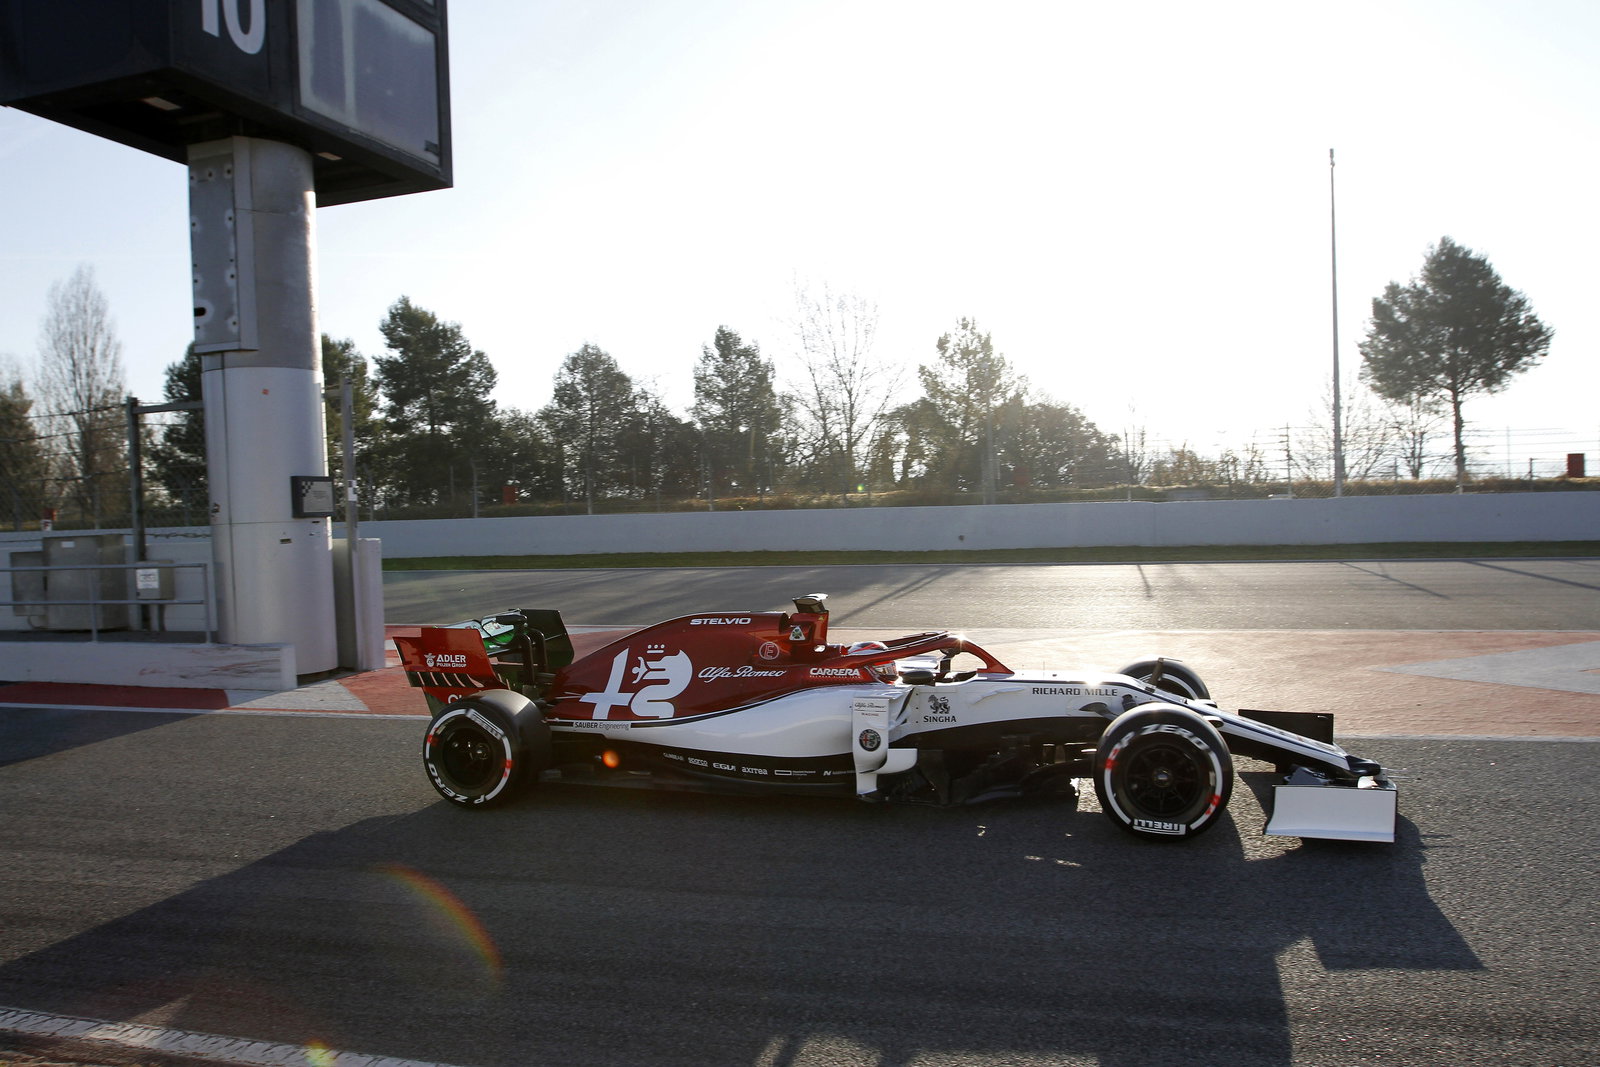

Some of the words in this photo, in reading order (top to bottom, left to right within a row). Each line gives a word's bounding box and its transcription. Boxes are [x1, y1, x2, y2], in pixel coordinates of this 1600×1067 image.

[690, 617, 752, 625] STELVIO
[436, 654, 466, 663] ADLER
[698, 666, 734, 683] Alfa
[733, 665, 787, 678] Romeo
[809, 667, 861, 676] CARRERA
[1032, 687, 1080, 696] RICHARD
[1085, 688, 1118, 696] MILLE
[923, 715, 957, 723] SINGHA
[574, 721, 599, 729] SAUBER
[599, 722, 630, 731] Engineering
[1140, 723, 1210, 751] ZERO
[428, 762, 469, 803] ZERO
[1132, 818, 1187, 836] PIRELLI
